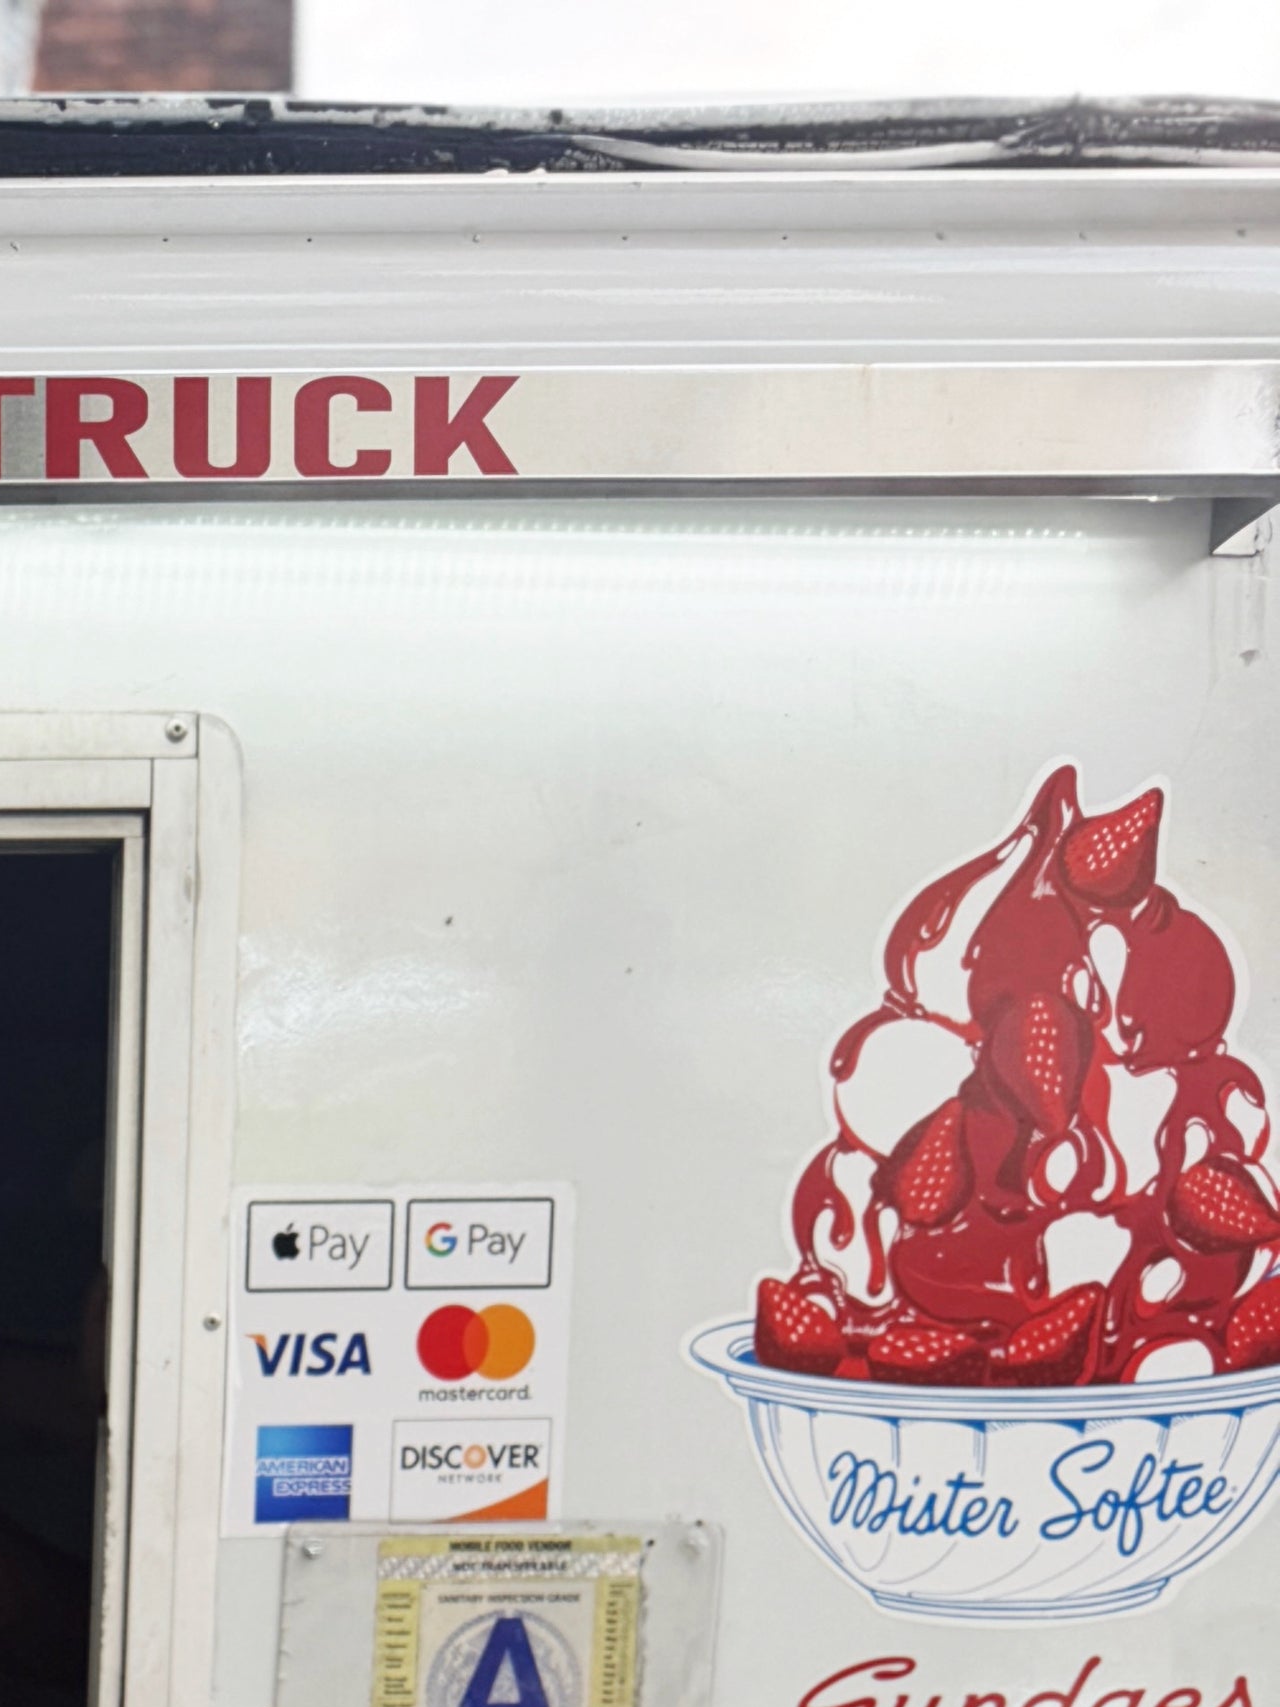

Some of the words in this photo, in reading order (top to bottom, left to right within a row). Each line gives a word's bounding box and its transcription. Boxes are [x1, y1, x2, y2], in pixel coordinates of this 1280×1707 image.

[309, 1225, 370, 1270] Pay
[425, 1222, 458, 1258] G
[468, 1224, 526, 1264] Pay
[244, 1332, 372, 1377] VISA
[418, 1385, 531, 1402] mastercard
[257, 1458, 349, 1475] AMERICAN
[400, 1444, 540, 1470] DISCOVER
[274, 1478, 351, 1496] EXPRESS
[828, 1450, 1019, 1538] Mister
[1040, 1439, 1234, 1556] Softee
